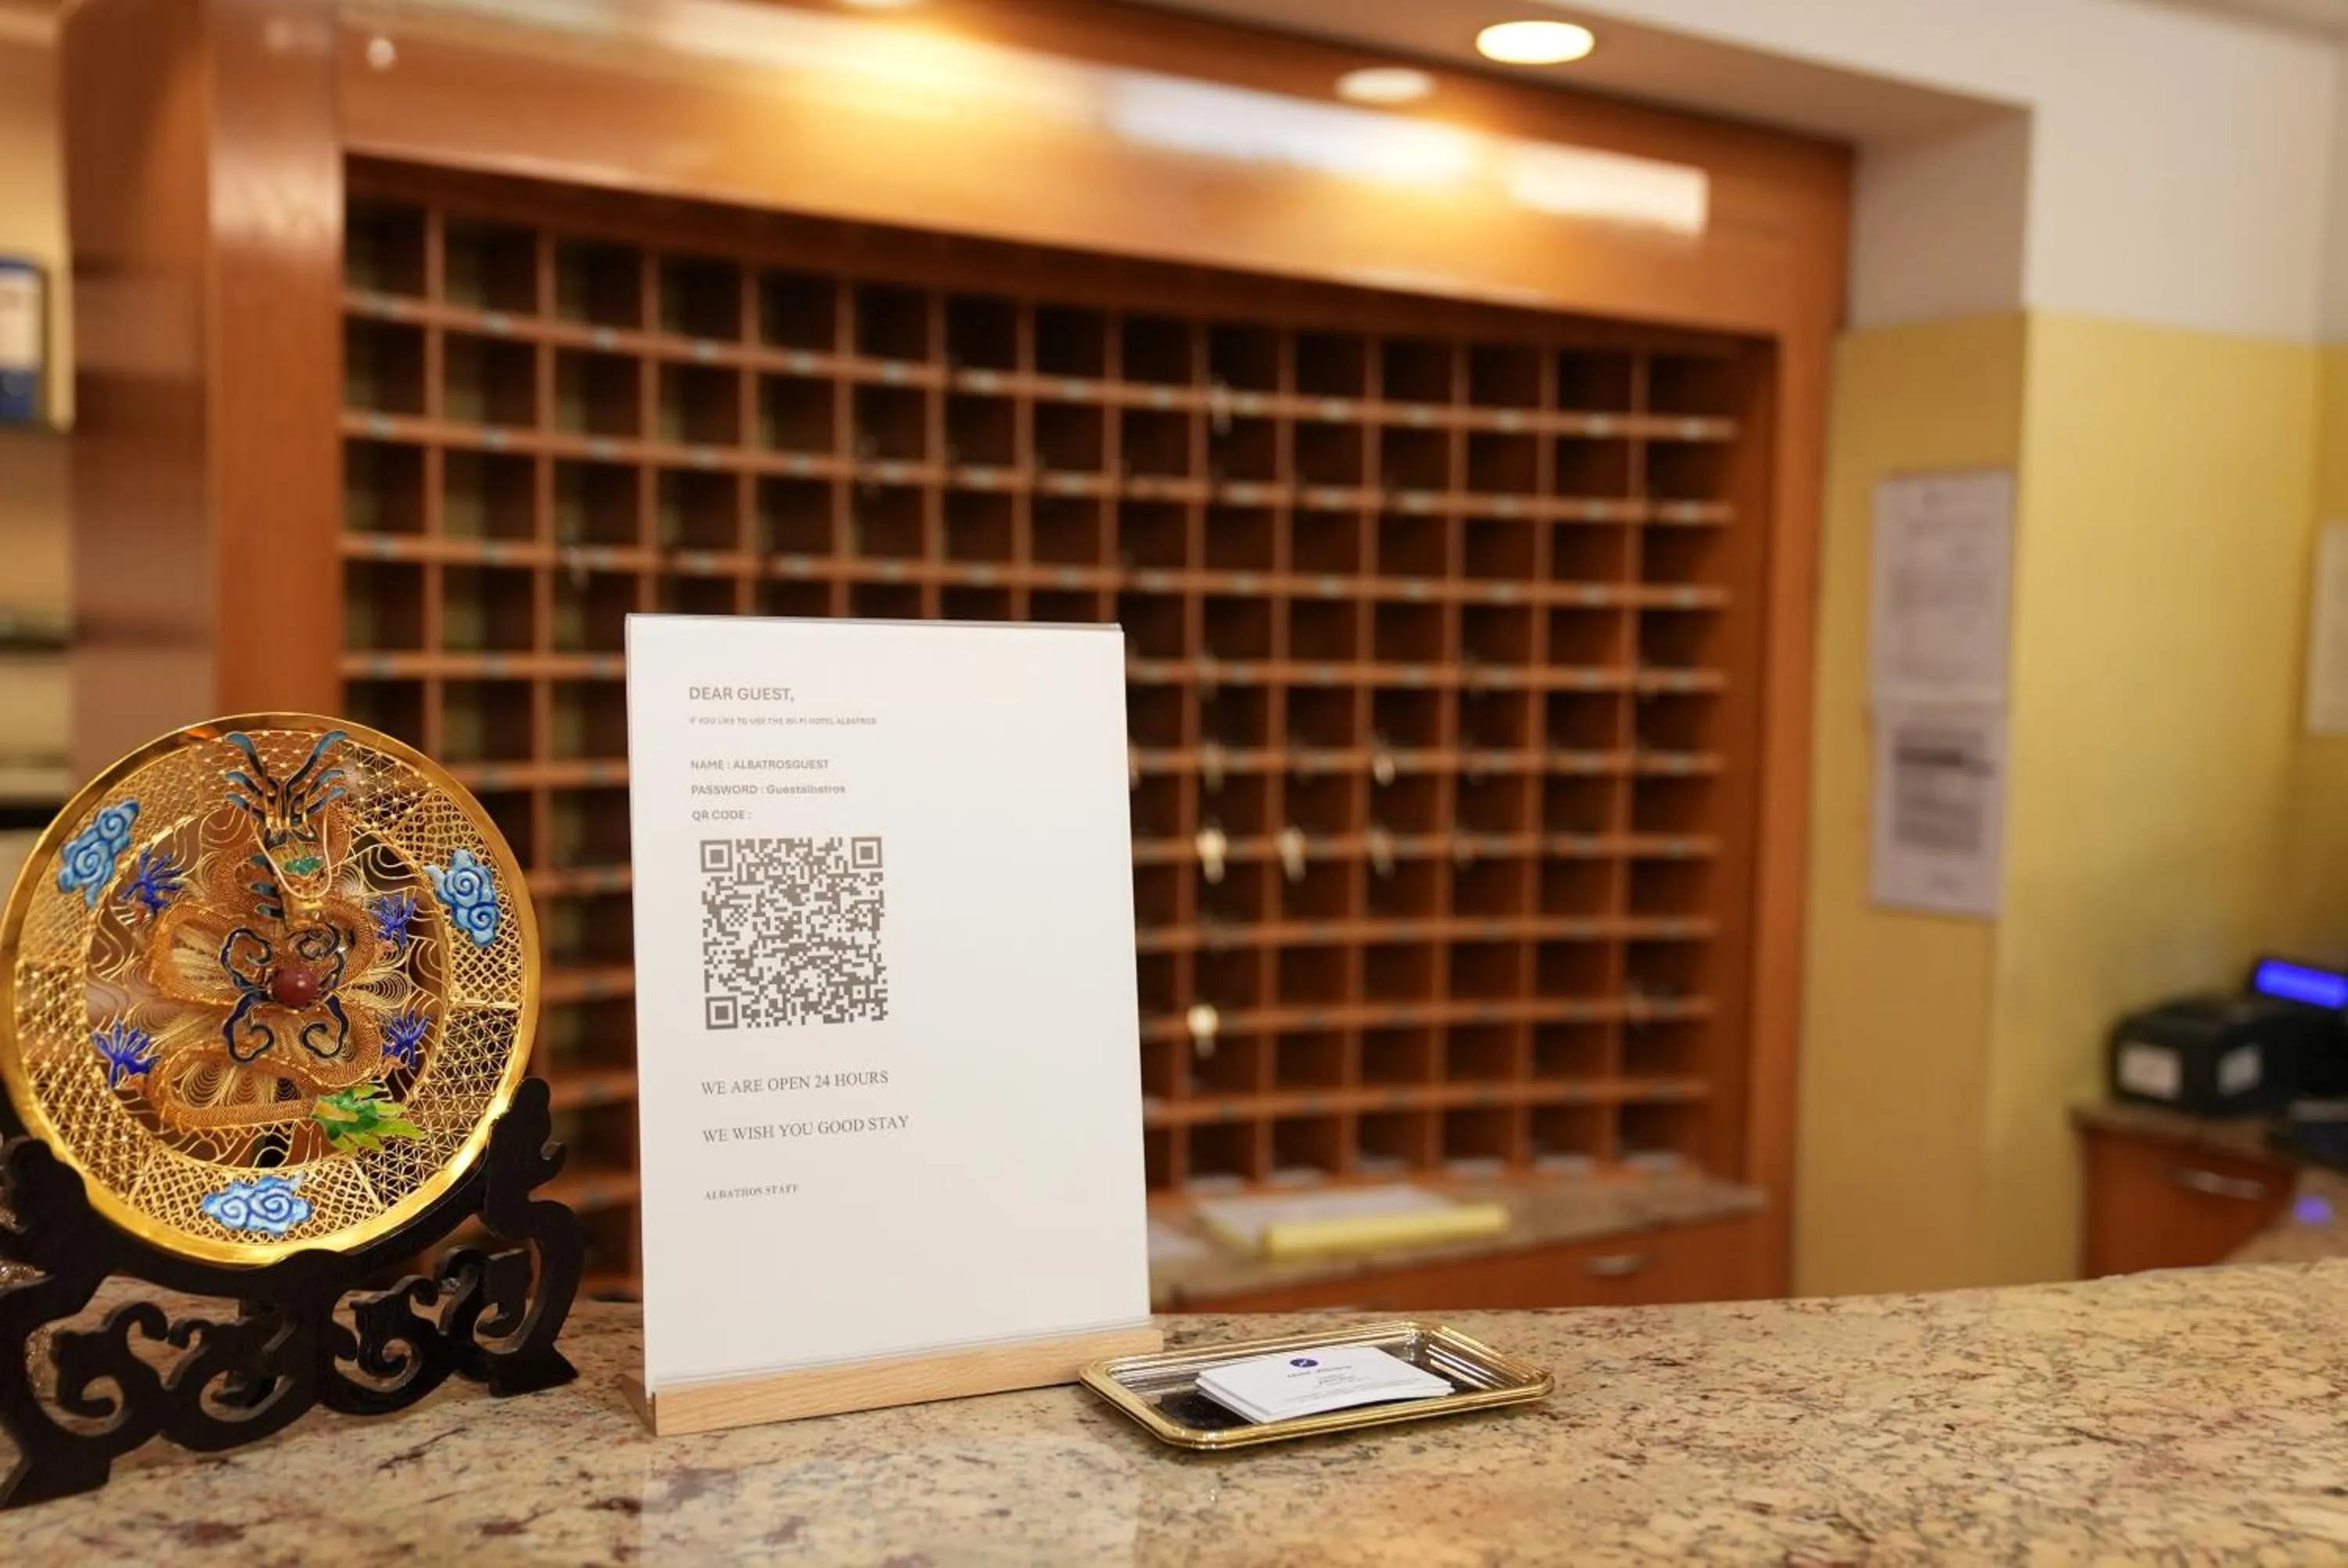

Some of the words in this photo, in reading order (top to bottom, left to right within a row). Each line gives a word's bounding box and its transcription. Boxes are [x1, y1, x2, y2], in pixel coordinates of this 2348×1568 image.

[689, 686, 733, 700] DEAR
[737, 687, 794, 703] GUEST,
[698, 717, 716, 726] YOU
[718, 717, 734, 726] LIKE
[737, 717, 747, 726] TO
[749, 717, 766, 726] USE
[768, 717, 783, 726] THE
[808, 717, 834, 726] HOTEL
[836, 717, 877, 726] ALBATROS
[690, 760, 724, 770] NAME
[733, 759, 829, 770] ALBATROSGUEST
[691, 785, 758, 795] PASSWORD
[691, 810, 709, 822] QR
[711, 810, 746, 820] CODE
[701, 1081, 727, 1095] WE
[730, 1078, 765, 1094] ARE
[767, 1076, 812, 1091] OPEN
[814, 1074, 831, 1089] 24
[834, 1070, 889, 1088] HOURS
[702, 1129, 729, 1144] WE
[733, 1124, 775, 1142] WISH
[779, 1122, 814, 1138] YOU
[818, 1118, 865, 1135] GOOD
[868, 1115, 909, 1131] STAY
[704, 1186, 763, 1201] ALBATROS
[765, 1183, 800, 1196] STAFF
